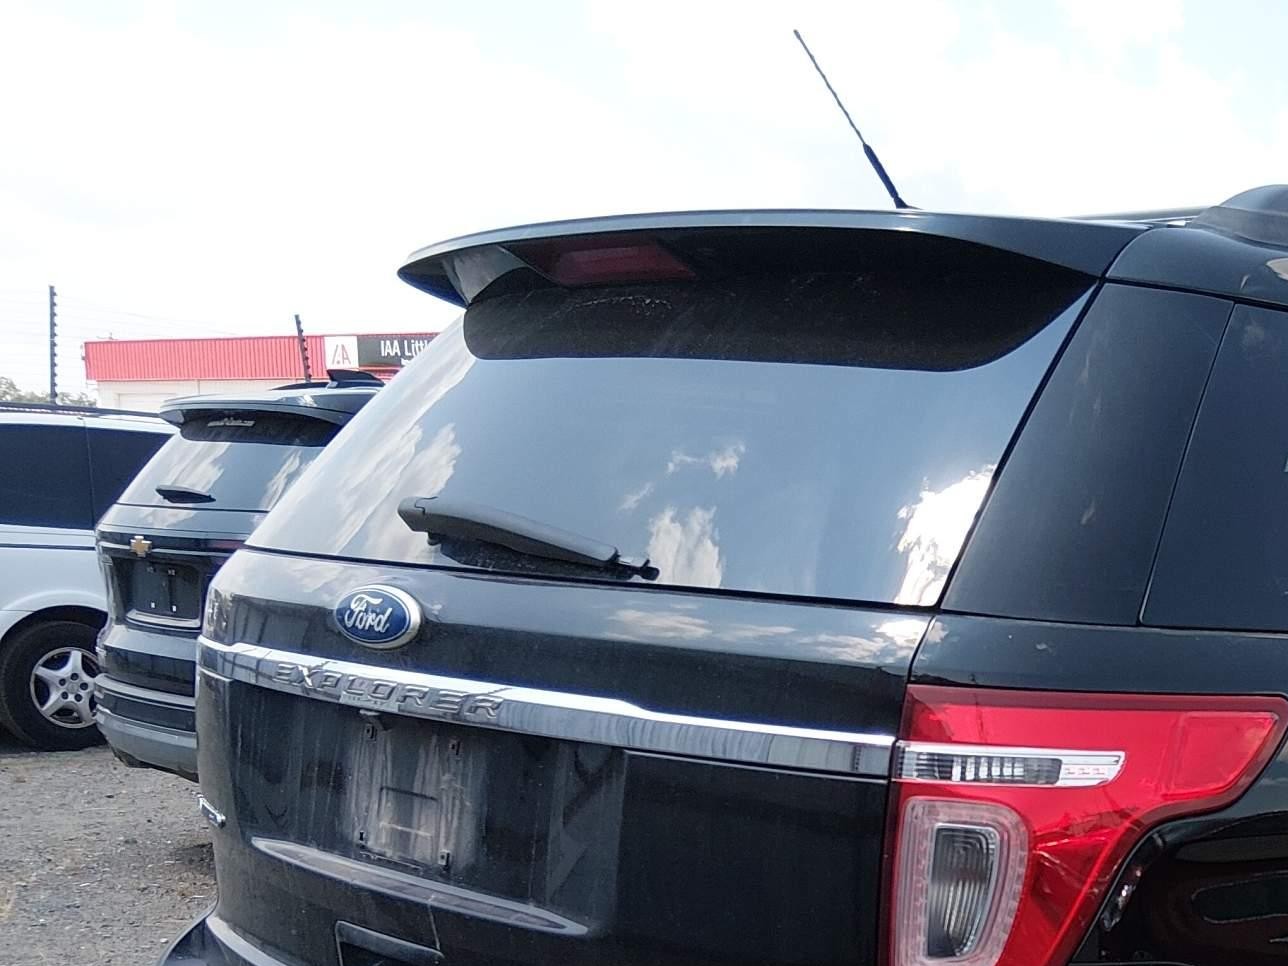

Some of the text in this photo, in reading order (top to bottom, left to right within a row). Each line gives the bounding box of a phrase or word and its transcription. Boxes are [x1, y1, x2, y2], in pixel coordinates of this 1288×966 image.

[380, 340, 401, 357] IAA
[344, 593, 393, 633] Ford
[271, 661, 505, 720] EXPLORER
